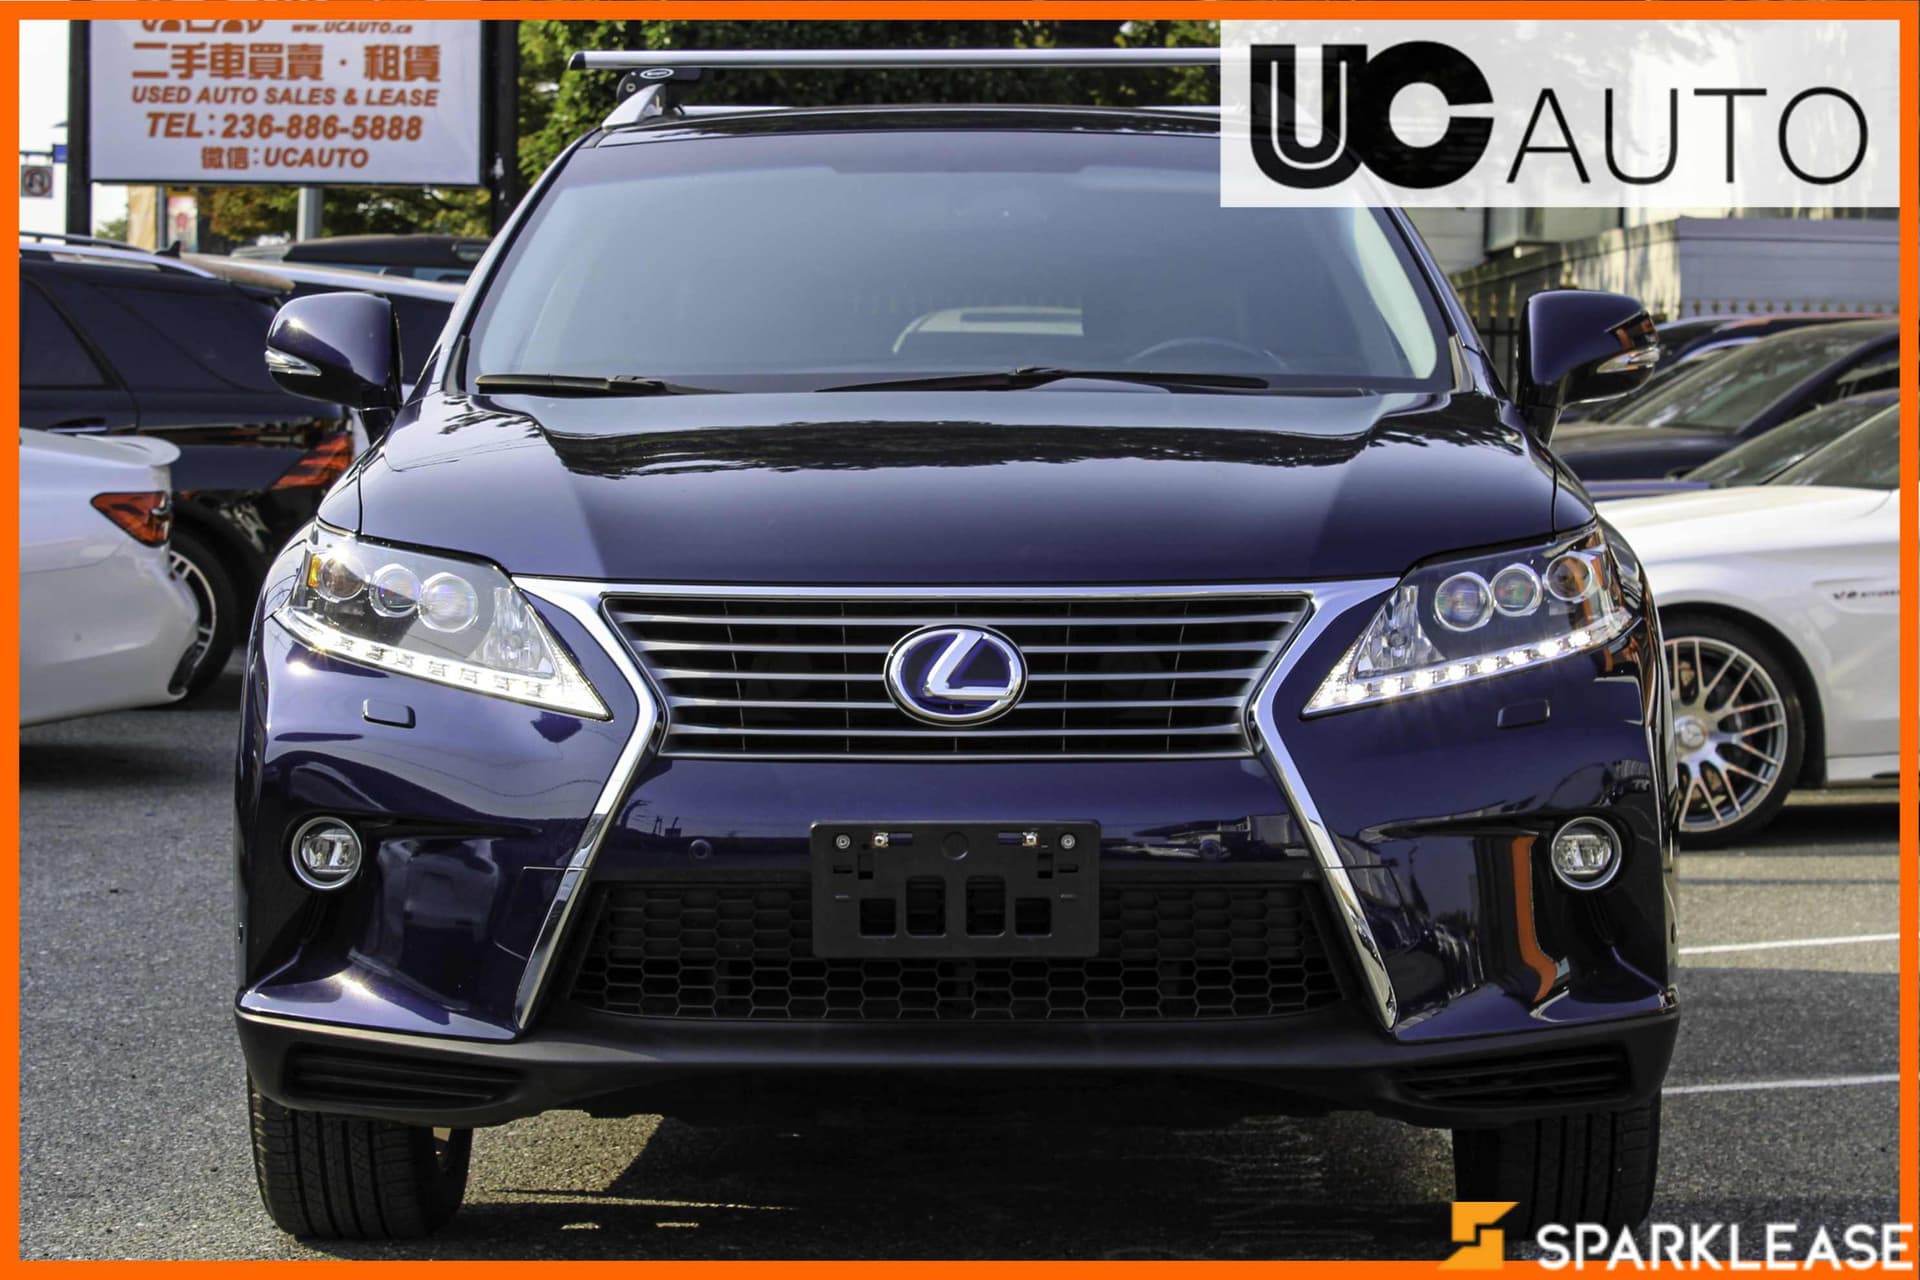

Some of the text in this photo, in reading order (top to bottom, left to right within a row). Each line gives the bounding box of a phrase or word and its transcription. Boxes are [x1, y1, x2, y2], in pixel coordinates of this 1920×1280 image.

[132, 85, 439, 107] USED AUTO SALES & LEASE
